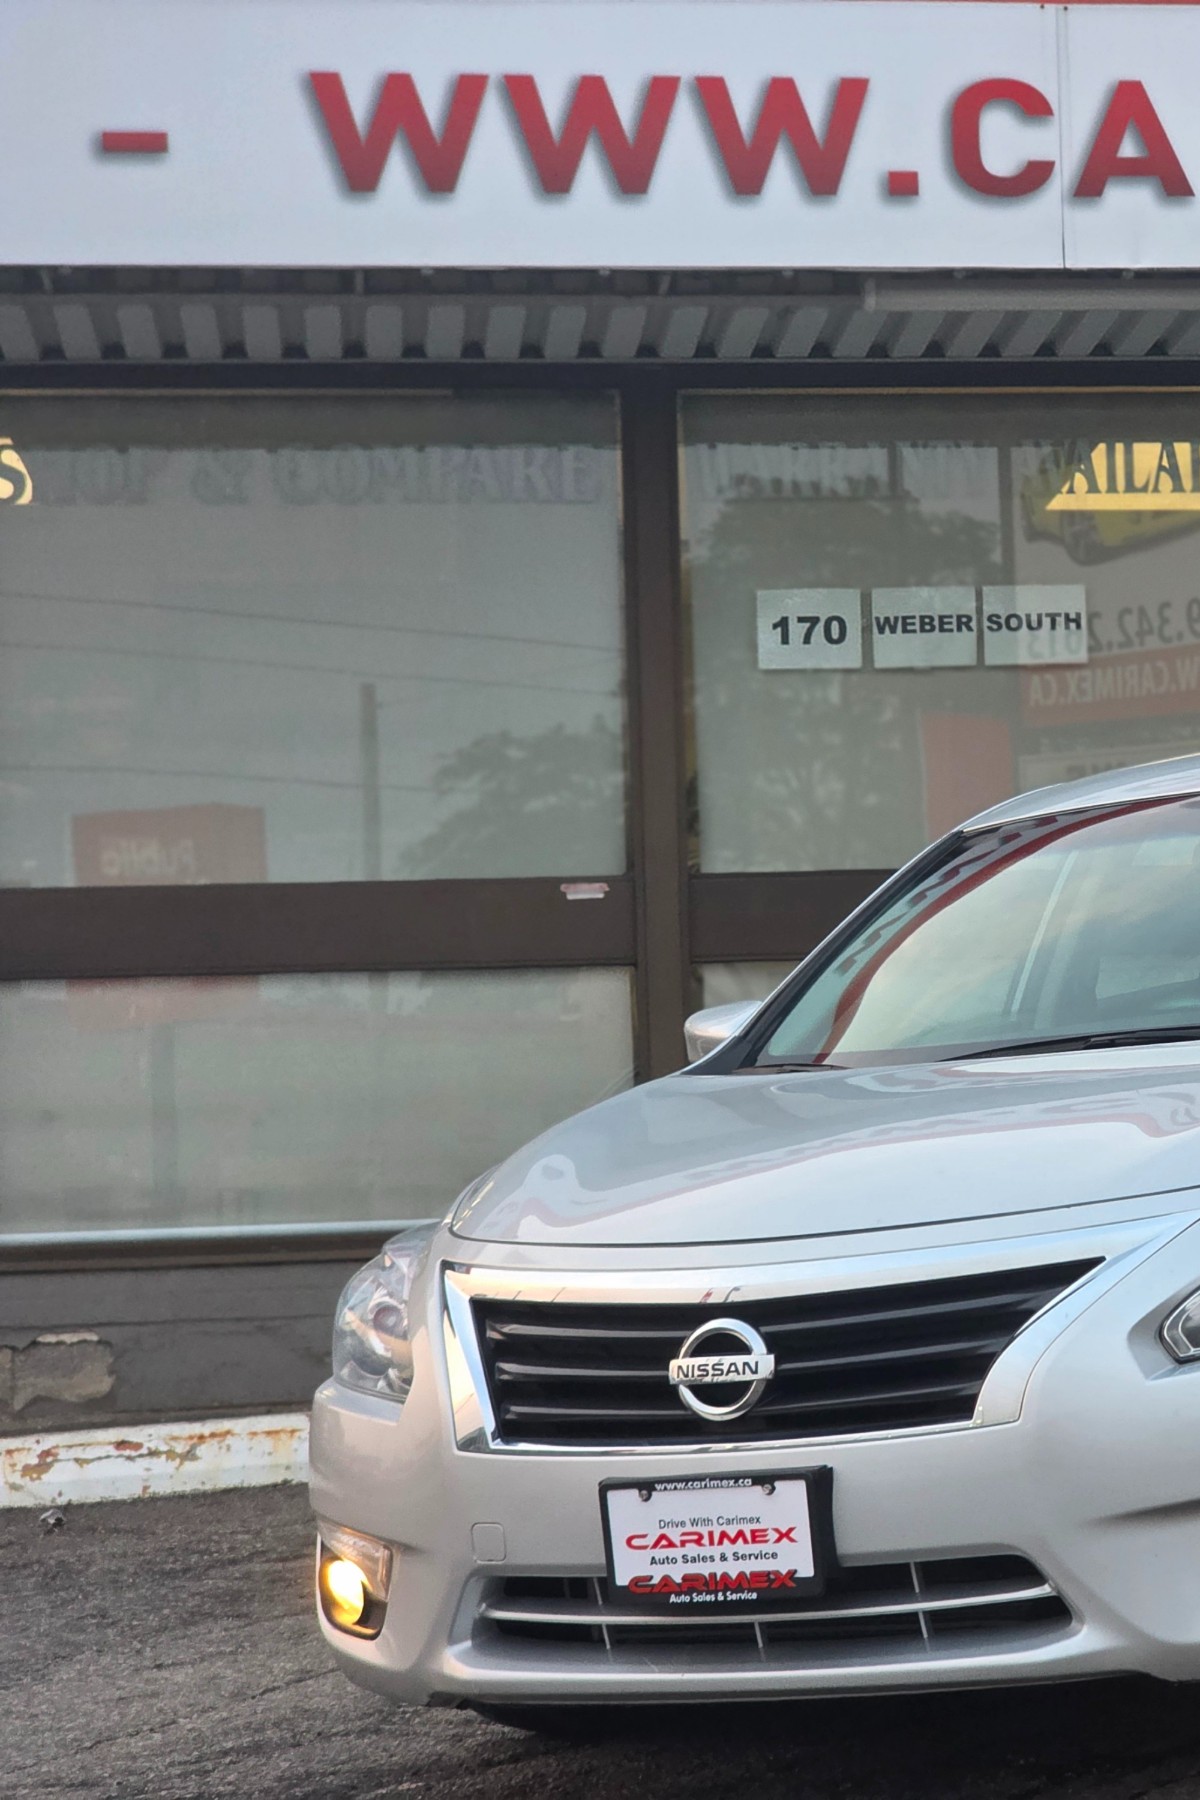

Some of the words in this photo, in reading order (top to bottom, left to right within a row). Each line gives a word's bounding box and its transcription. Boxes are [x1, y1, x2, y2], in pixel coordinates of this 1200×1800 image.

[771, 615, 847, 646] 170
[874, 613, 975, 635] WEBER
[986, 611, 1083, 632] SOUTH
[676, 1360, 759, 1379] NISSAN
[654, 1477, 753, 1492] www.carimex.ca
[658, 1518, 687, 1530] Drive
[689, 1517, 714, 1529] With
[716, 1514, 762, 1527] Carimex
[625, 1526, 798, 1551] CARIMEX
[649, 1555, 678, 1567] Auto
[681, 1552, 716, 1565] Sales
[719, 1552, 729, 1563] &
[732, 1550, 779, 1563] Service
[628, 1569, 798, 1594] CARIMEX
[669, 1592, 691, 1604] Auto
[691, 1591, 716, 1603] Sales
[717, 1591, 725, 1602] &
[726, 1590, 758, 1602] Service
